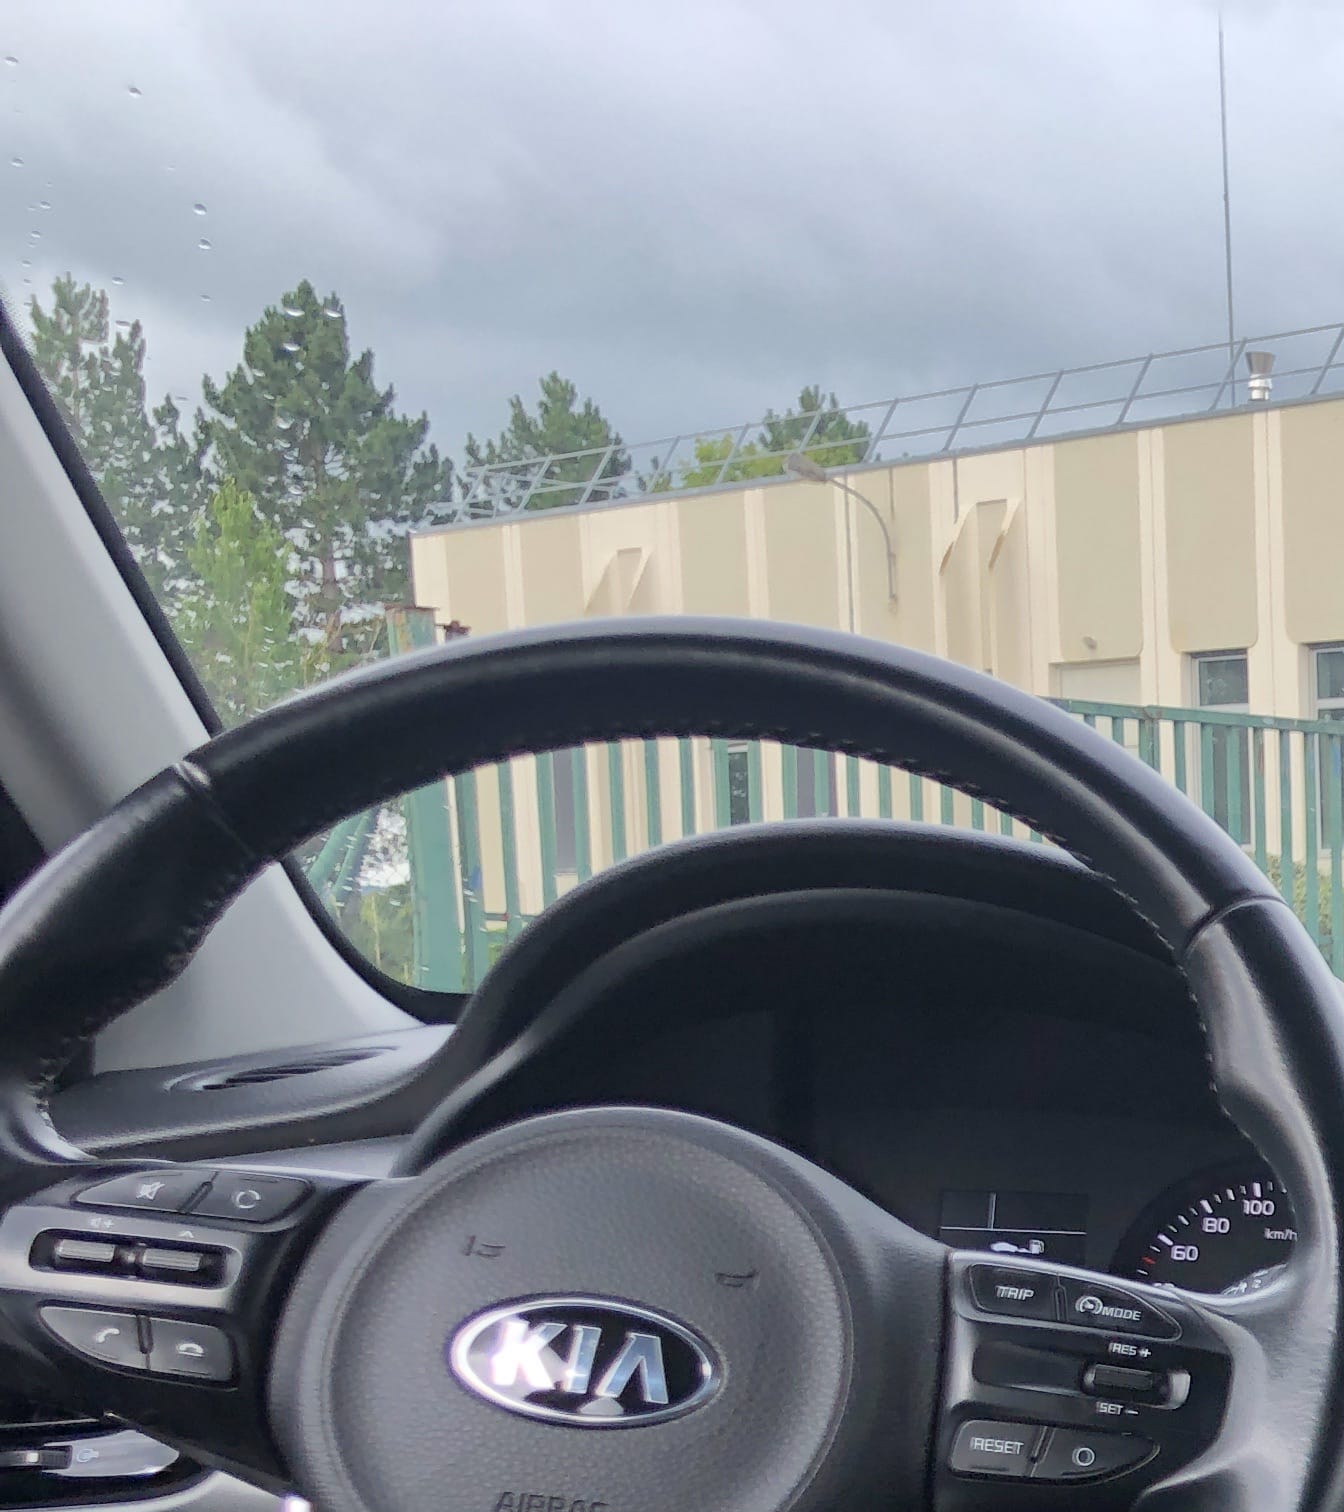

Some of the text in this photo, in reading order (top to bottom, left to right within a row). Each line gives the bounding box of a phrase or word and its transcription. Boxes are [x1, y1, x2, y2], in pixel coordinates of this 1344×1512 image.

[1243, 1199, 1276, 1216] 100
[1202, 1217, 1231, 1234] 80
[1264, 1228, 1298, 1241] km/h
[1170, 1245, 1199, 1261] 60
[995, 1285, 1035, 1300] TRIP
[1101, 1307, 1142, 1321] MODE
[1109, 1342, 1138, 1356] RES
[491, 1318, 669, 1405] KIA
[1096, 1401, 1124, 1415] SET
[970, 1434, 1025, 1456] RESET
